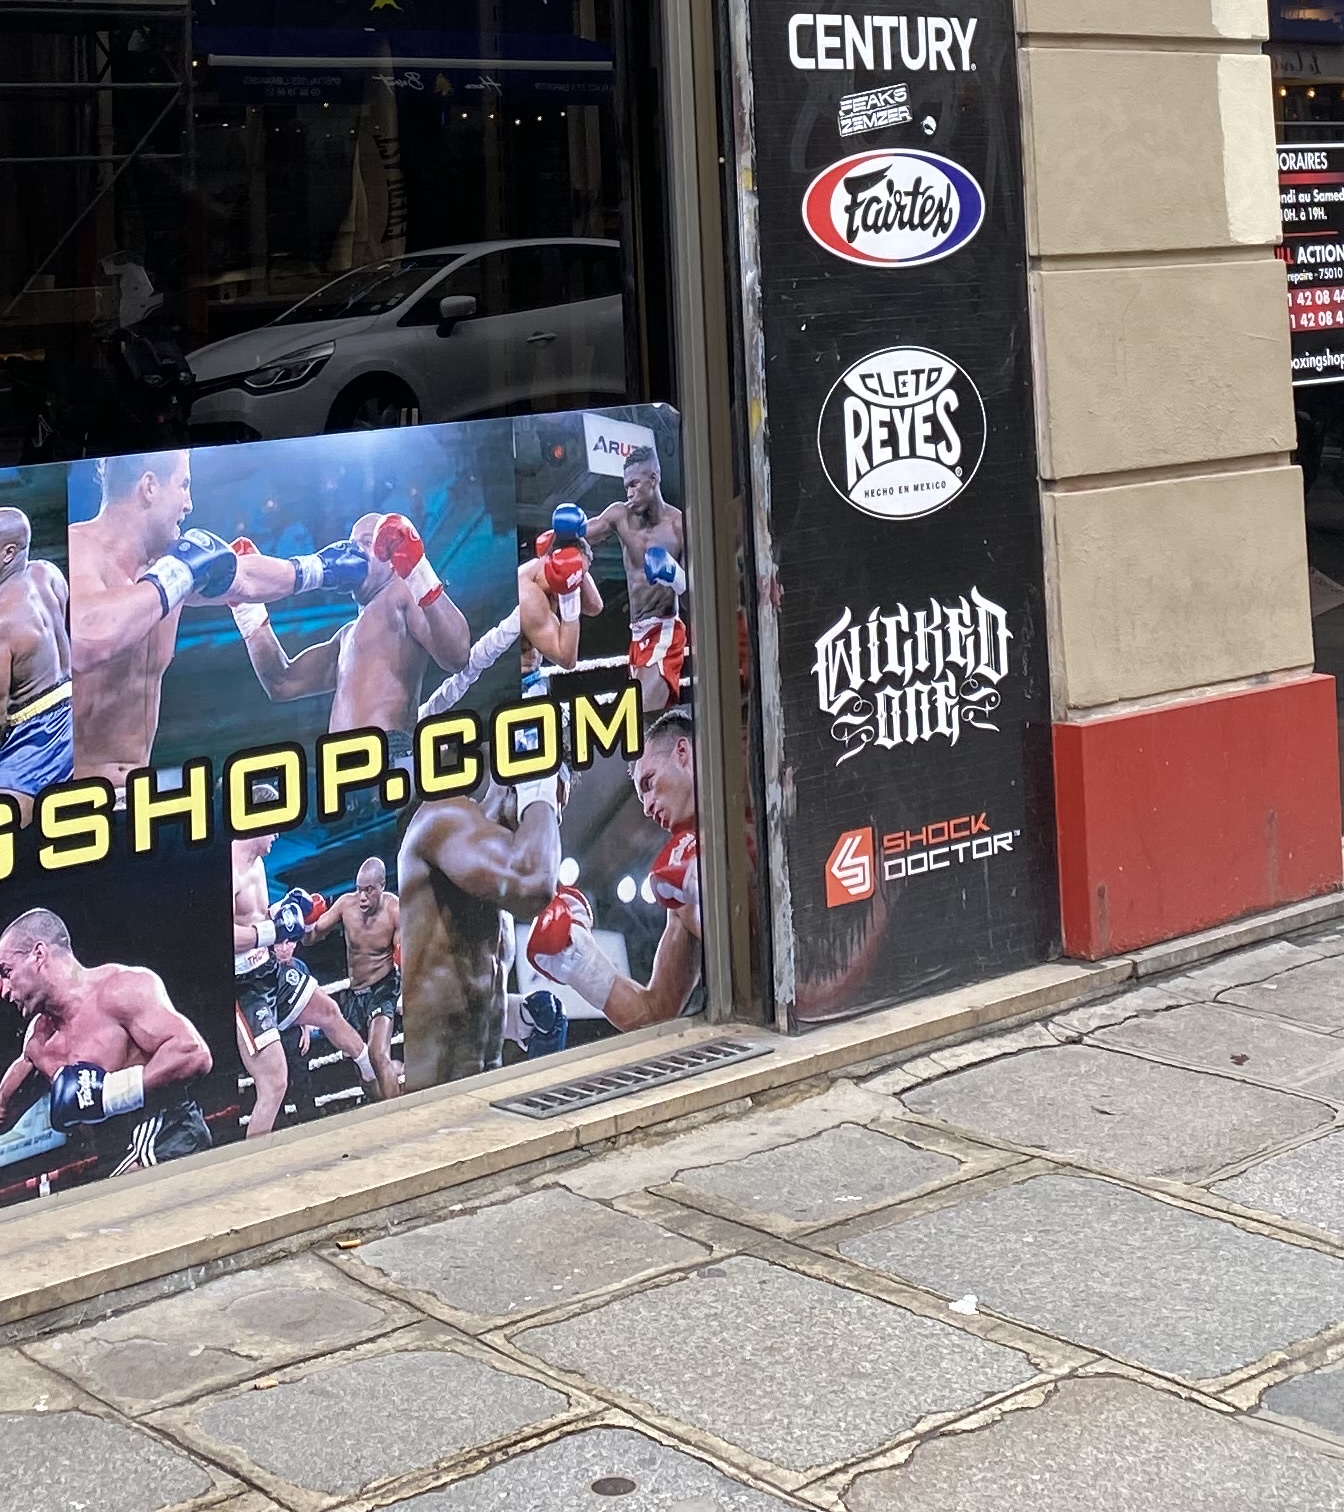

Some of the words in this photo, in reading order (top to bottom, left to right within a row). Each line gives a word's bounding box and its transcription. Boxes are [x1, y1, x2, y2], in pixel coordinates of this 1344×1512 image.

[788, 12, 977, 72] CENTURY
[844, 163, 953, 243] Fairtex
[1280, 188, 1296, 203] ndi
[1298, 192, 1311, 203] au
[1318, 266, 1343, 280] 75010
[1296, 290, 1313, 306] 42
[1314, 289, 1331, 305] 08
[1299, 312, 1316, 328] 42
[1317, 310, 1334, 326] 08
[859, 366, 943, 399] CLETO
[843, 388, 962, 491] REYES
[864, 486, 895, 499] HECHO
[811, 584, 1016, 716] WICKED
[882, 812, 992, 854] SHOCK
[883, 832, 1016, 882] DOCTOR
